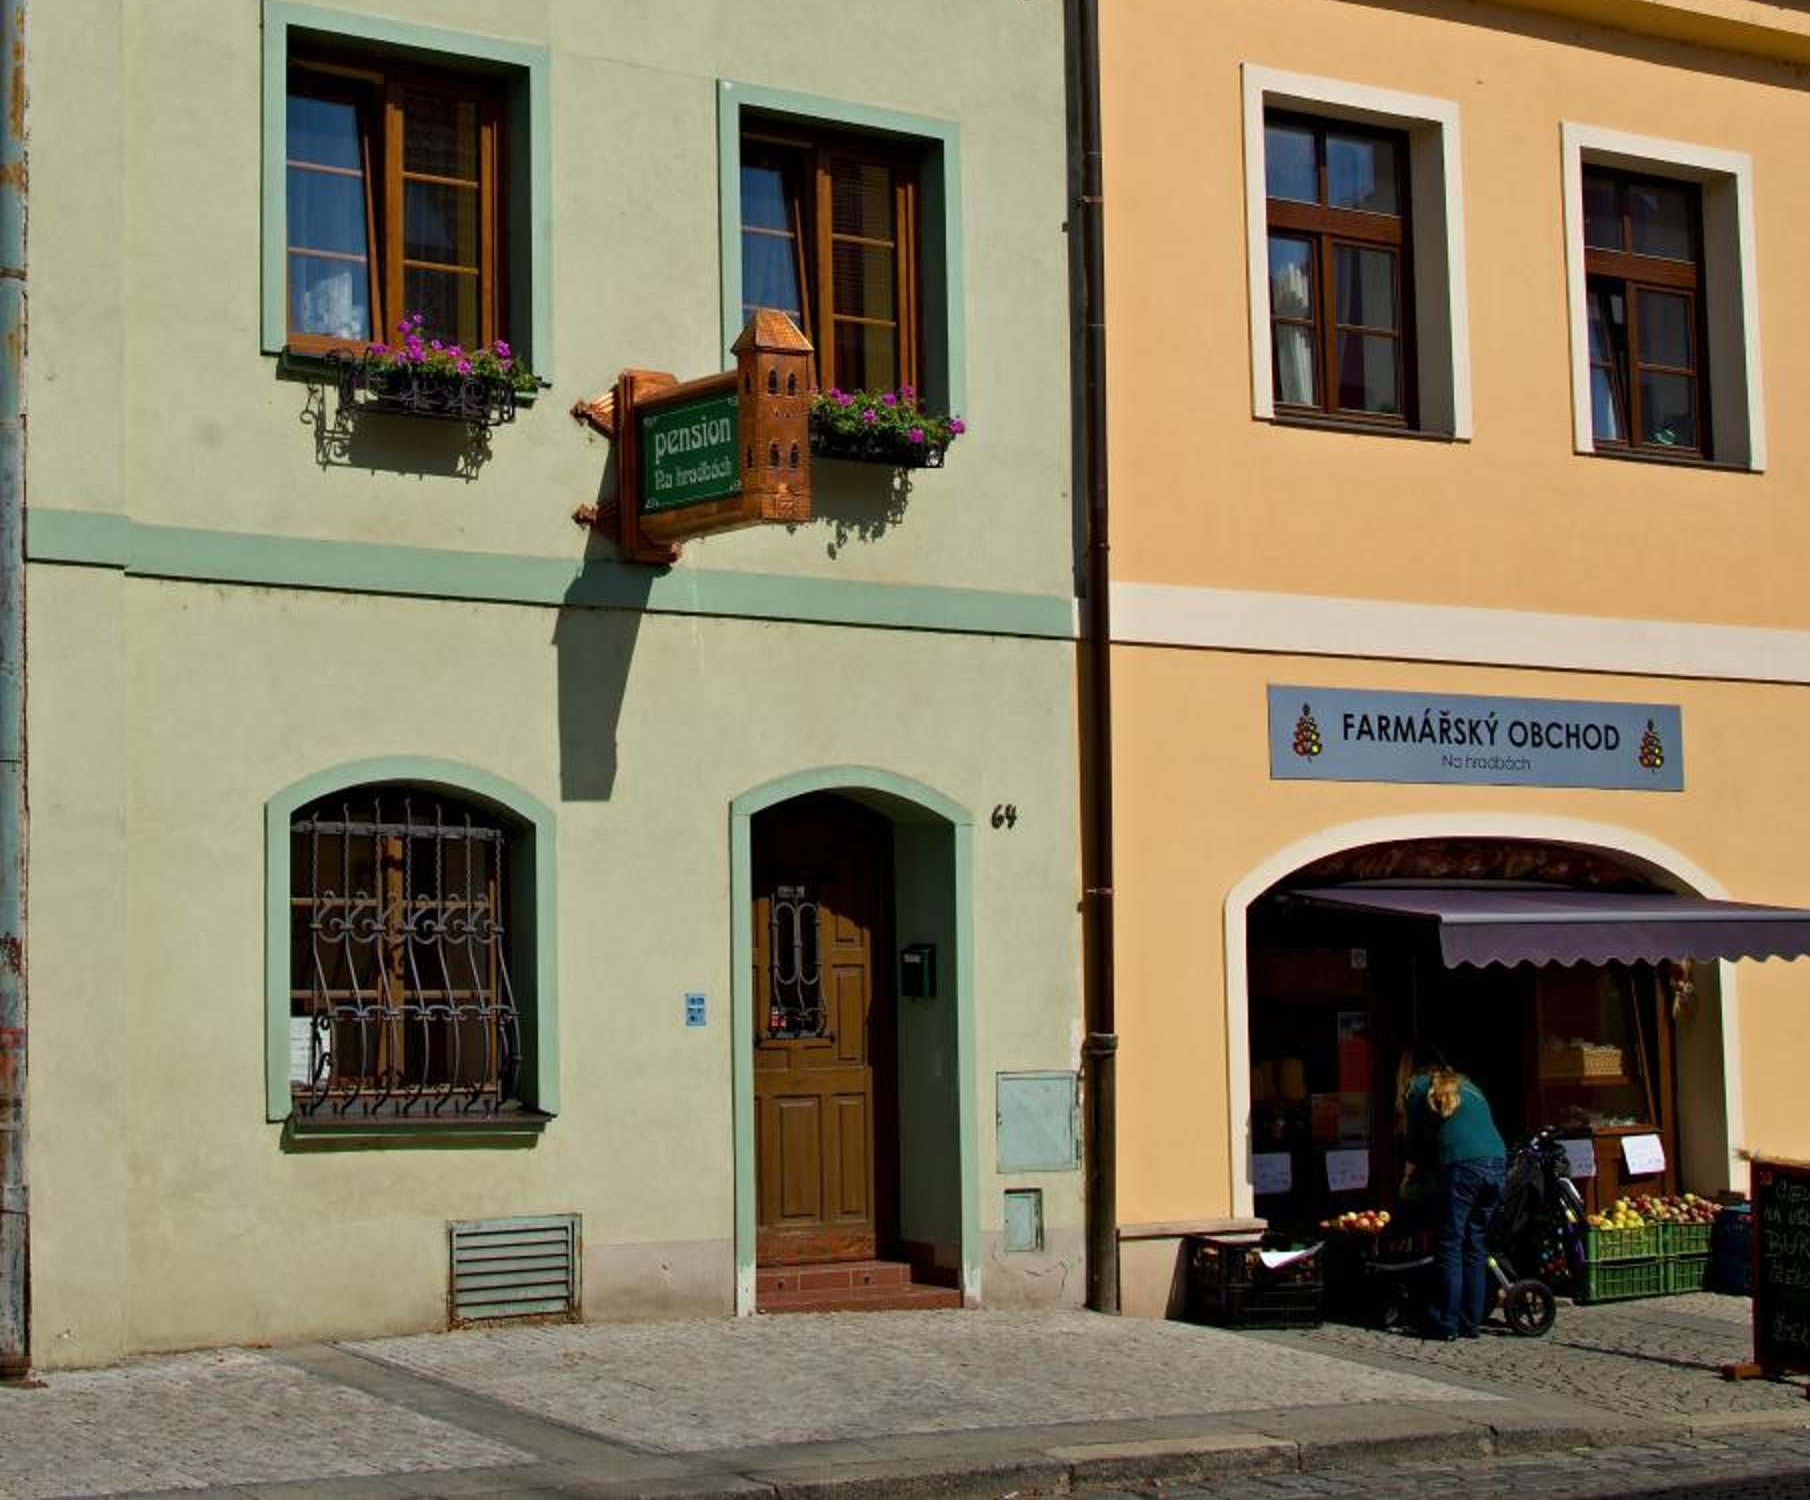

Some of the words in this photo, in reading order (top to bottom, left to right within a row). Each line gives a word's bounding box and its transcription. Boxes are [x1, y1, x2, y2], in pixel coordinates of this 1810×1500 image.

[655, 414, 731, 465] pension
[1342, 707, 1499, 746] FARMÁŘSKÝ
[1508, 719, 1621, 751] OBCHOD
[1441, 754, 1463, 769] Na
[1465, 755, 1531, 771] hradbách
